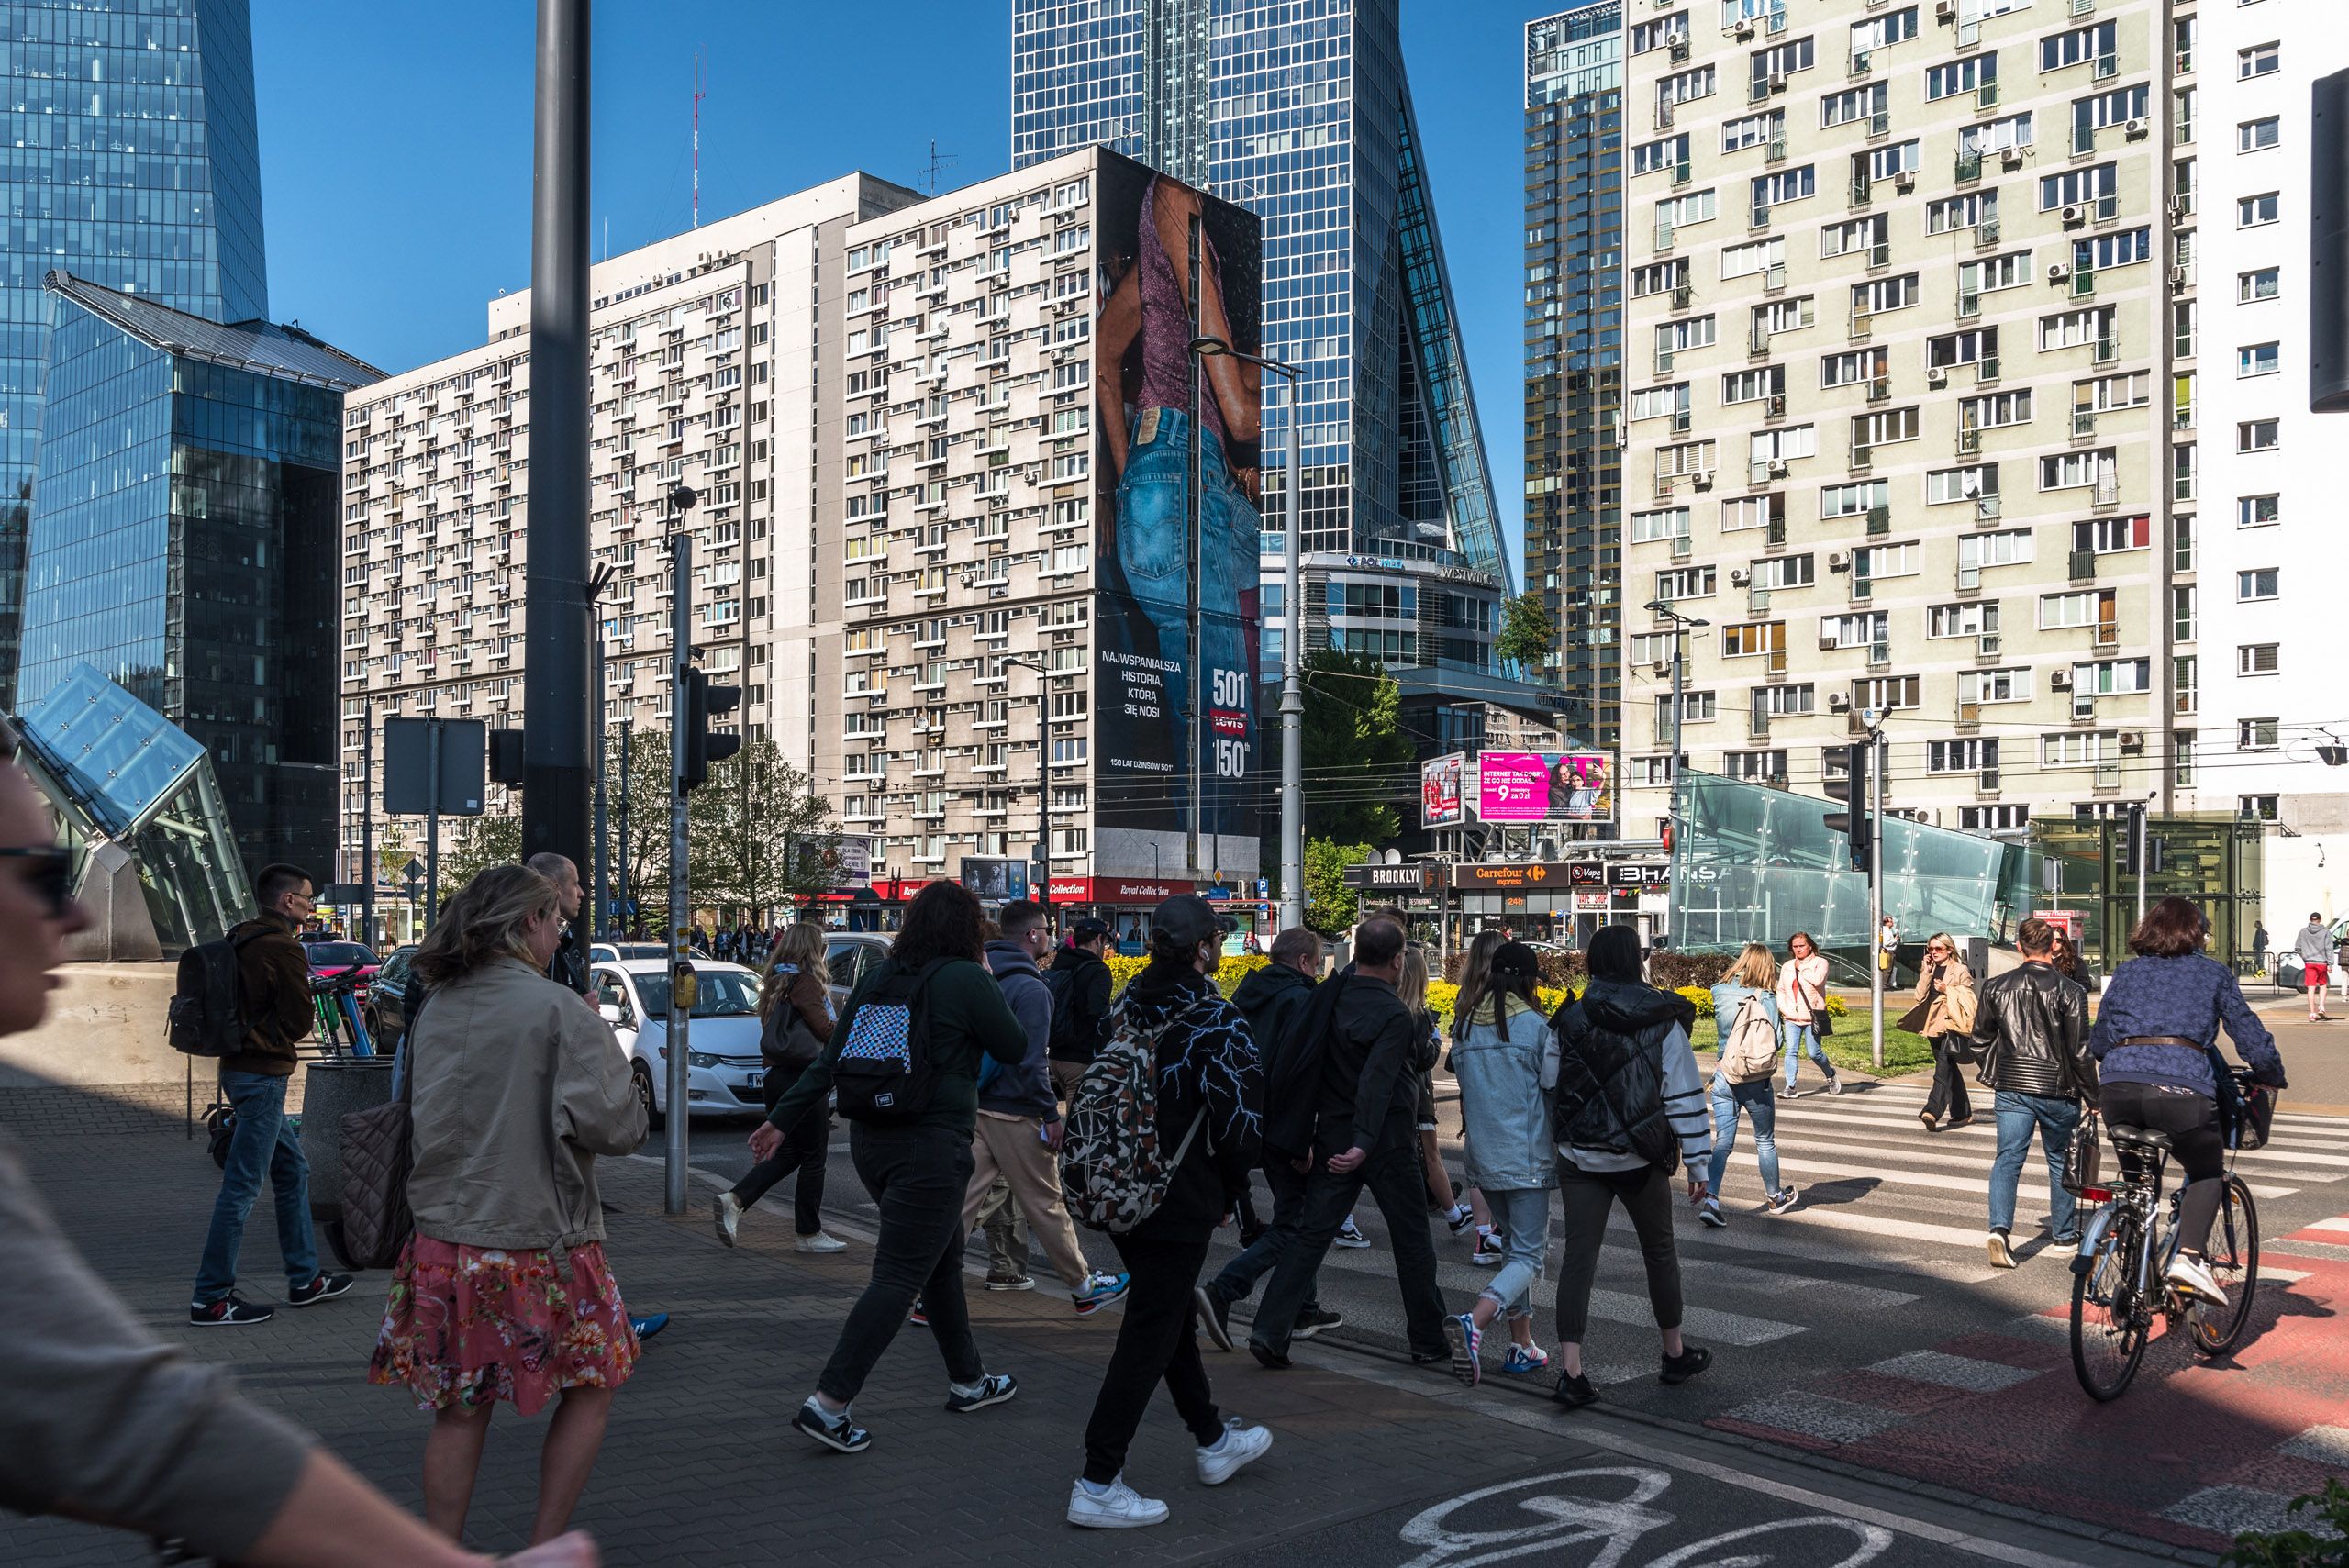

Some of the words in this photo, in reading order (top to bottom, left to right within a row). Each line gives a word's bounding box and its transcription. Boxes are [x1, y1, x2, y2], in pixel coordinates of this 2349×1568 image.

[1102, 651, 1181, 673] NAJWSPANIALSZA
[1121, 673, 1163, 687] HISTORIA,
[1128, 687, 1157, 704] KTÓRĄ
[1124, 703, 1138, 718] SIĘ
[1140, 705, 1160, 718] NOSI
[1110, 758, 1122, 767] 150
[1122, 759, 1133, 768] LAT
[1133, 760, 1161, 771] DŻINSÓW
[1497, 784, 1509, 802] 9
[1373, 869, 1419, 884] BROOKLY
[1476, 867, 1523, 878] Carrefour
[1584, 868, 1601, 879] Vape
[1260, 881, 1265, 891] P
[1497, 878, 1522, 886] express
[904, 886, 918, 897] Roya
[1030, 884, 1040, 896] Roy
[1049, 884, 1085, 895] Collection
[1120, 884, 1139, 896] Royal
[1508, 897, 1524, 906] 24h
